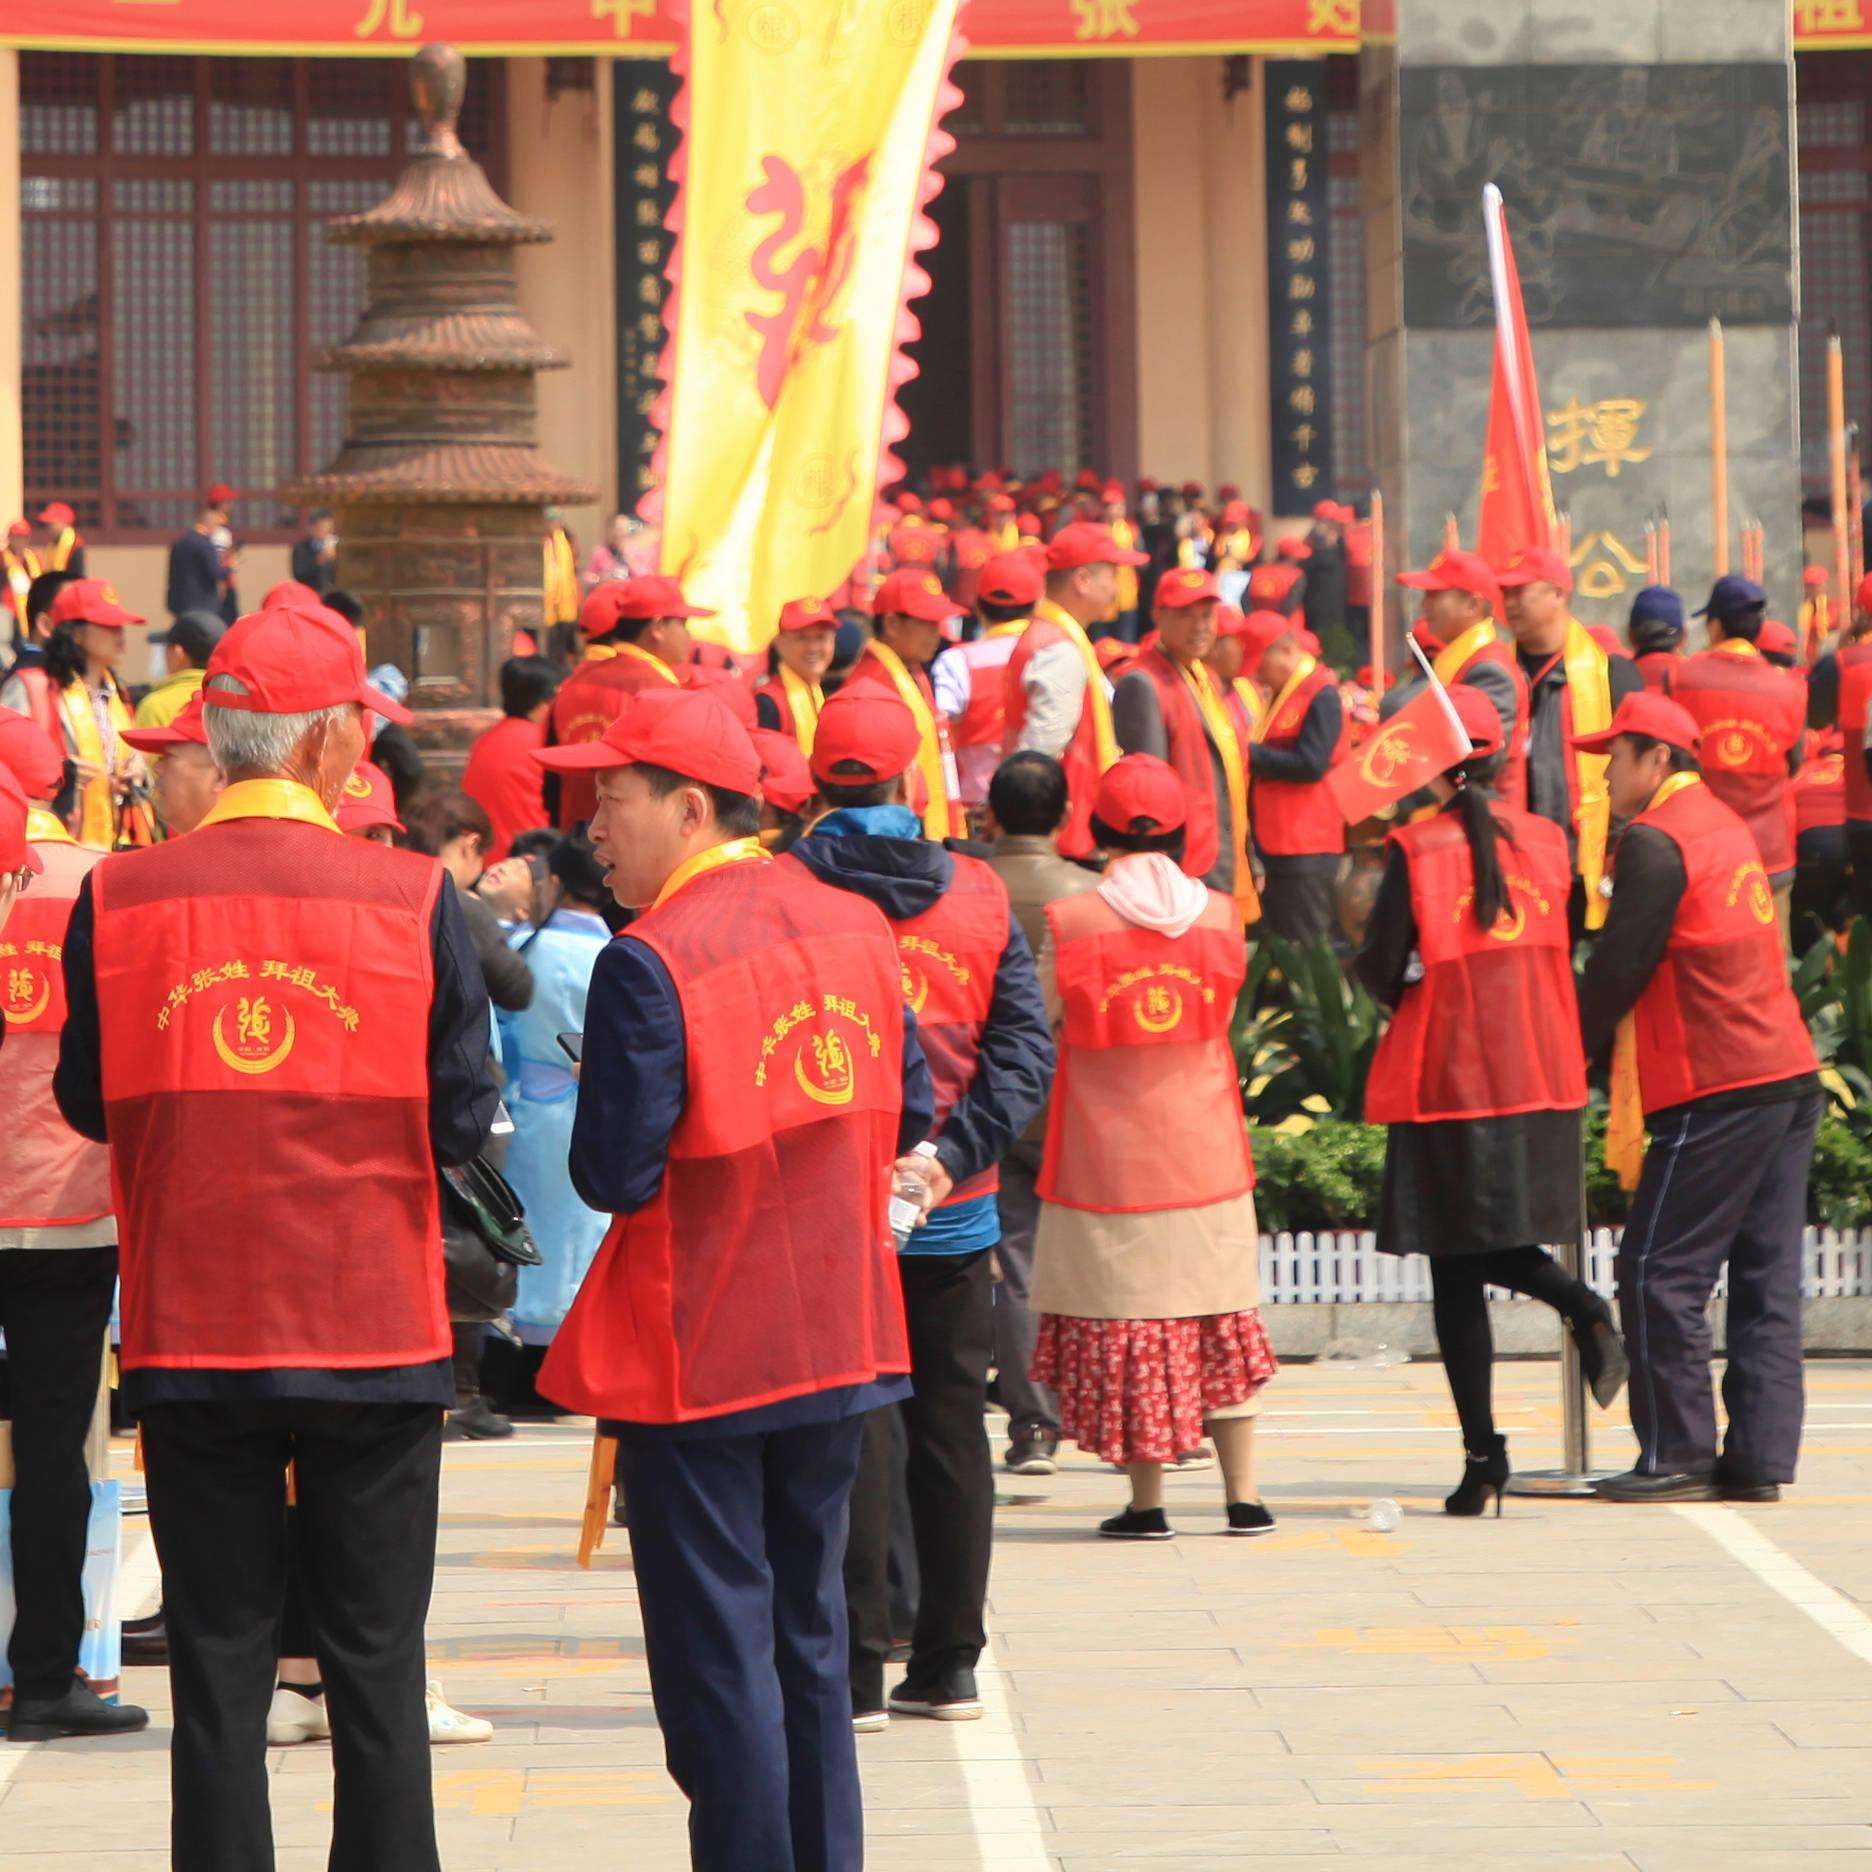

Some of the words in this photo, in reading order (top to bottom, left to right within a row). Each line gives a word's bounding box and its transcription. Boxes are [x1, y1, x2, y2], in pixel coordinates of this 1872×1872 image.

[157, 959, 361, 1032] 中华张姓拜祖大典
[754, 994, 881, 1087] 中华张姓拜祖大典
